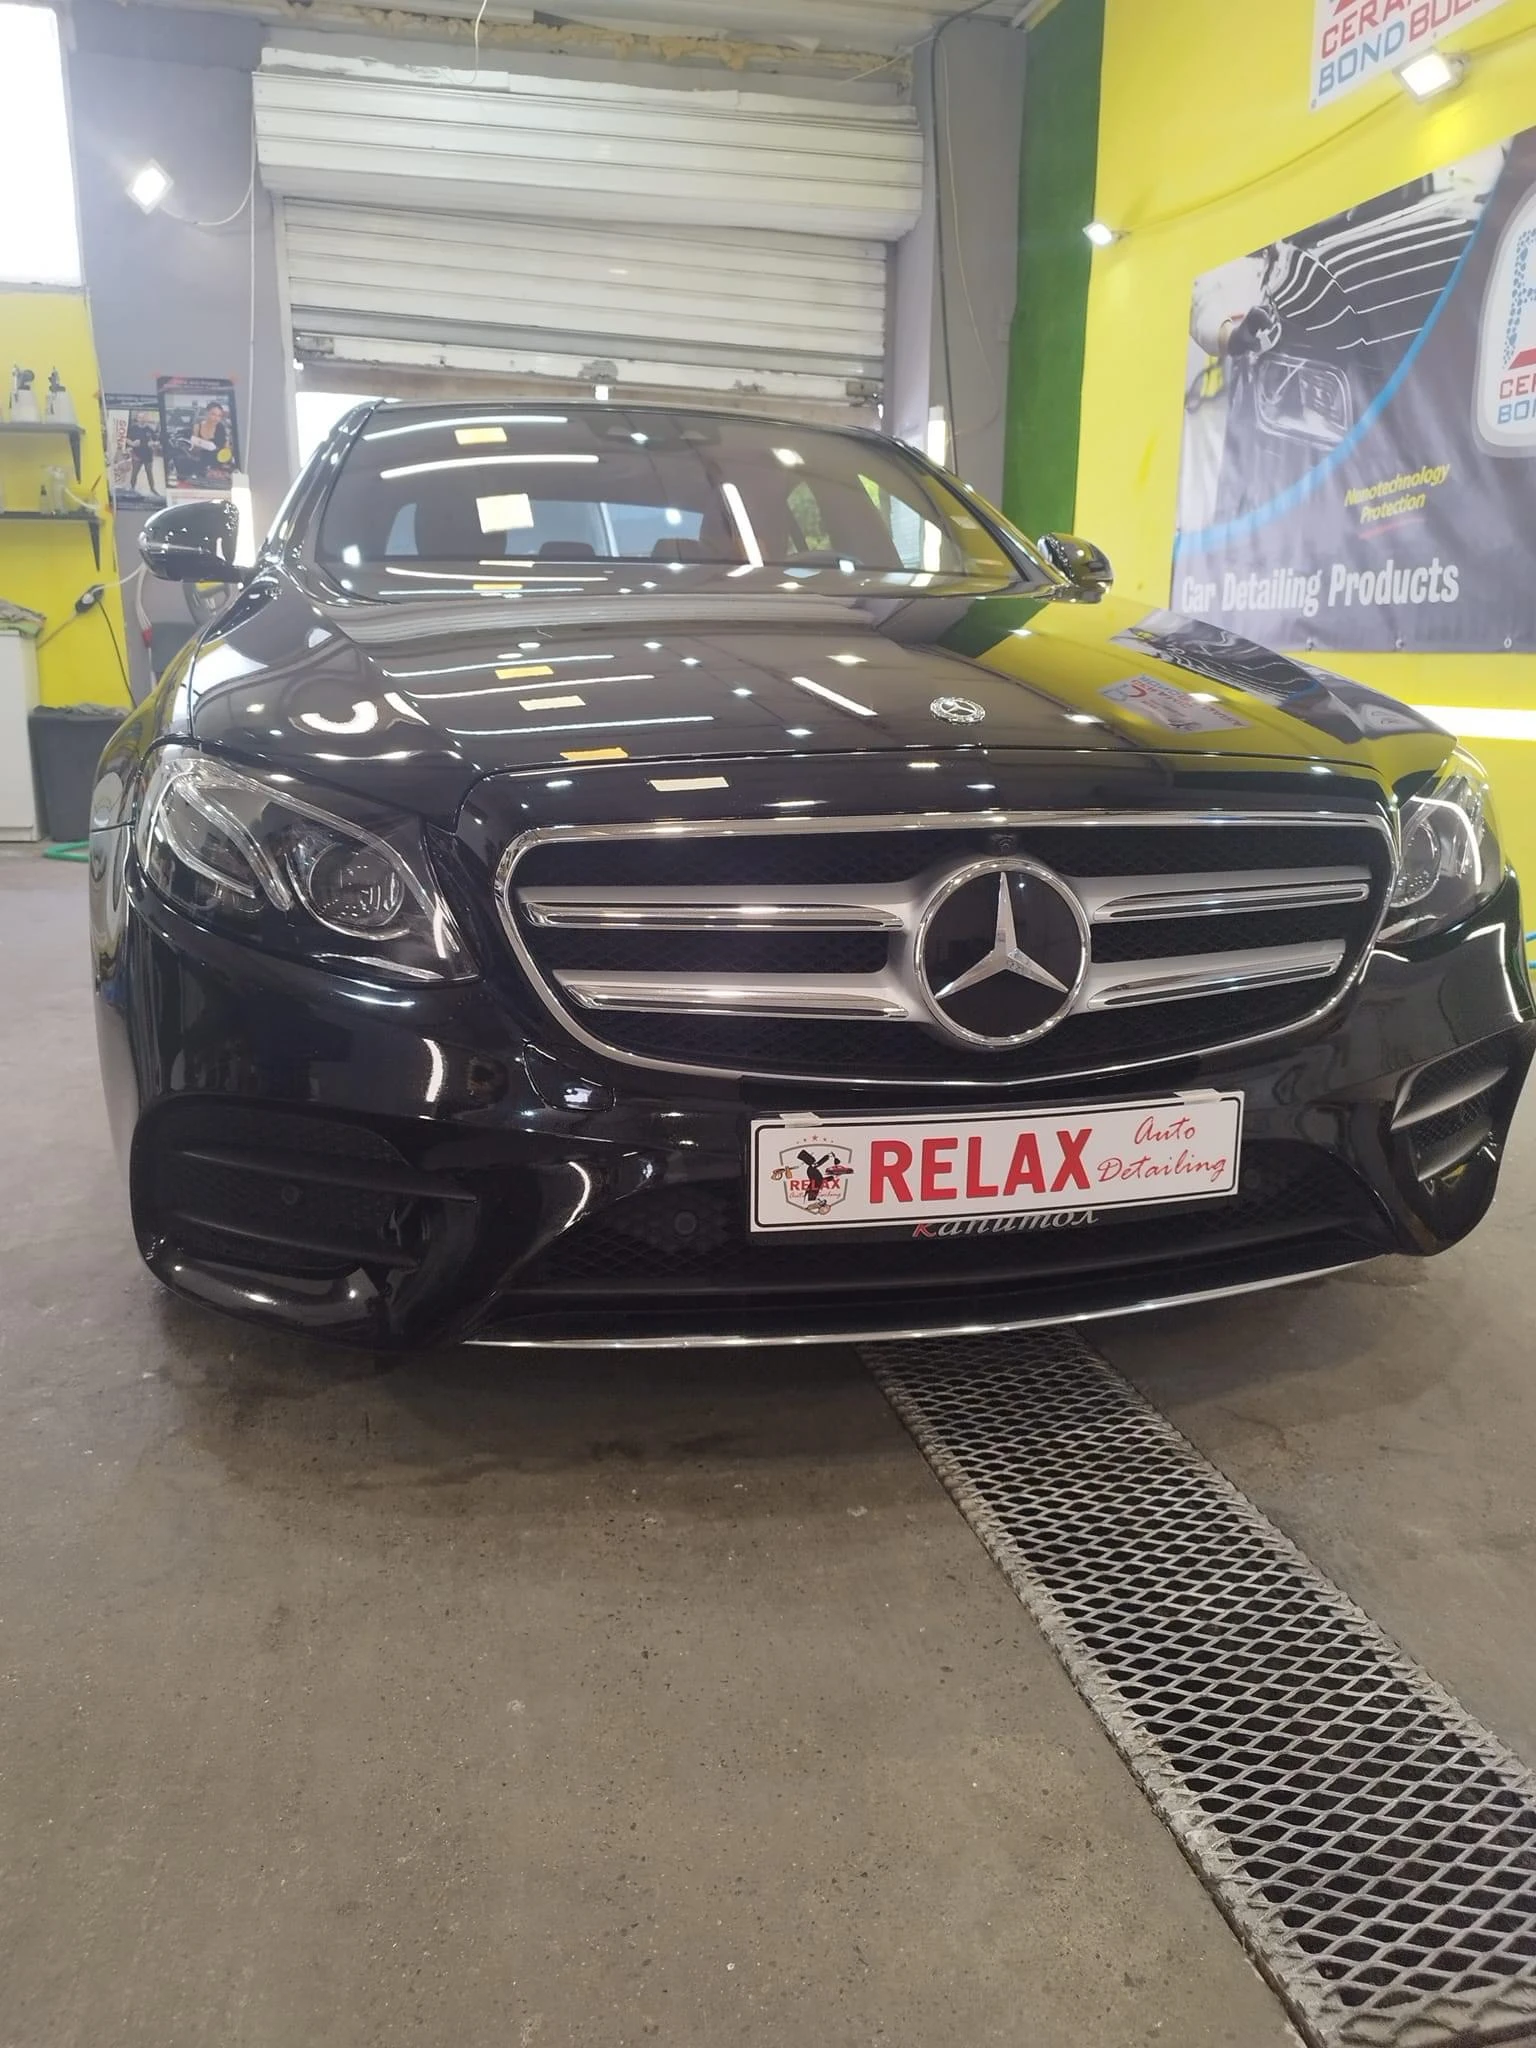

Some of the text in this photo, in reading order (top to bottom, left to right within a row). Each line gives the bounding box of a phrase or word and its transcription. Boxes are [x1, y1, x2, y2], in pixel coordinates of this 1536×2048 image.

[1321, 0, 1412, 59] CERA
[1497, 398, 1536, 425] BO
[1344, 463, 1450, 508] Nanotechnology
[1360, 493, 1426, 524] Protection
[1181, 557, 1460, 617] Car Detailing Products
[1133, 1115, 1196, 1145] Auto
[868, 1127, 1093, 1204] RELAX
[1096, 1149, 1227, 1184] Detailing
[790, 1178, 841, 1191] RELAX
